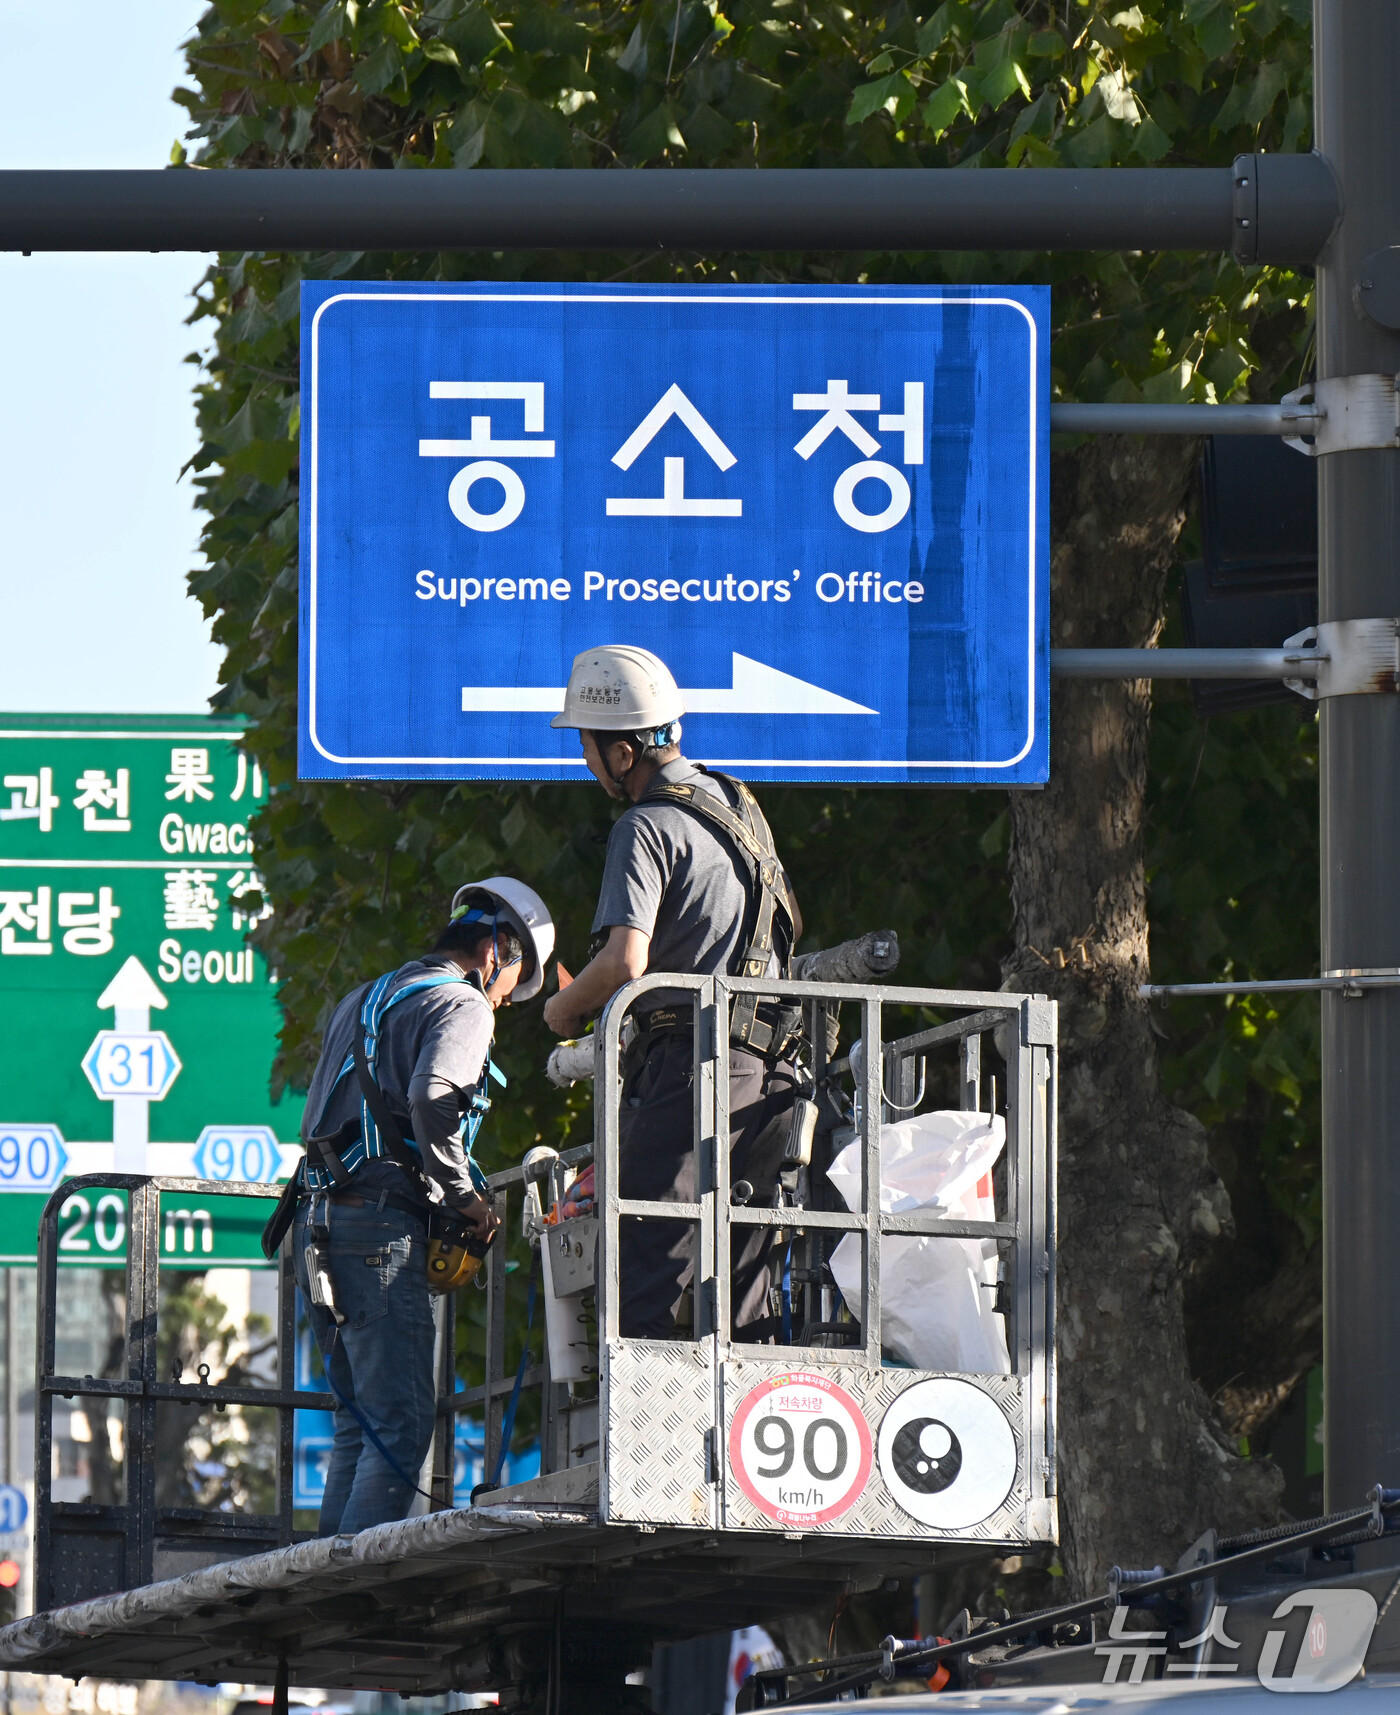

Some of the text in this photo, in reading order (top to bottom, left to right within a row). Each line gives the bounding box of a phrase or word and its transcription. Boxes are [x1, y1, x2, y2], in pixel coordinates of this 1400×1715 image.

[418, 379, 924, 533] 공소청
[415, 569, 571, 607] Supreme
[815, 572, 925, 603] Office
[0, 766, 132, 832] 과천
[159, 812, 256, 855] Gwac
[0, 885, 121, 956] 전당
[158, 938, 253, 984] Seoul
[107, 1044, 155, 1087] 31
[0, 1136, 50, 1180] 90
[211, 1138, 264, 1182] 90
[779, 1396, 823, 1411] 저속차량
[753, 1415, 848, 1481] 90
[778, 1486, 824, 1507] km/h
[1311, 1622, 1325, 1652] 10
